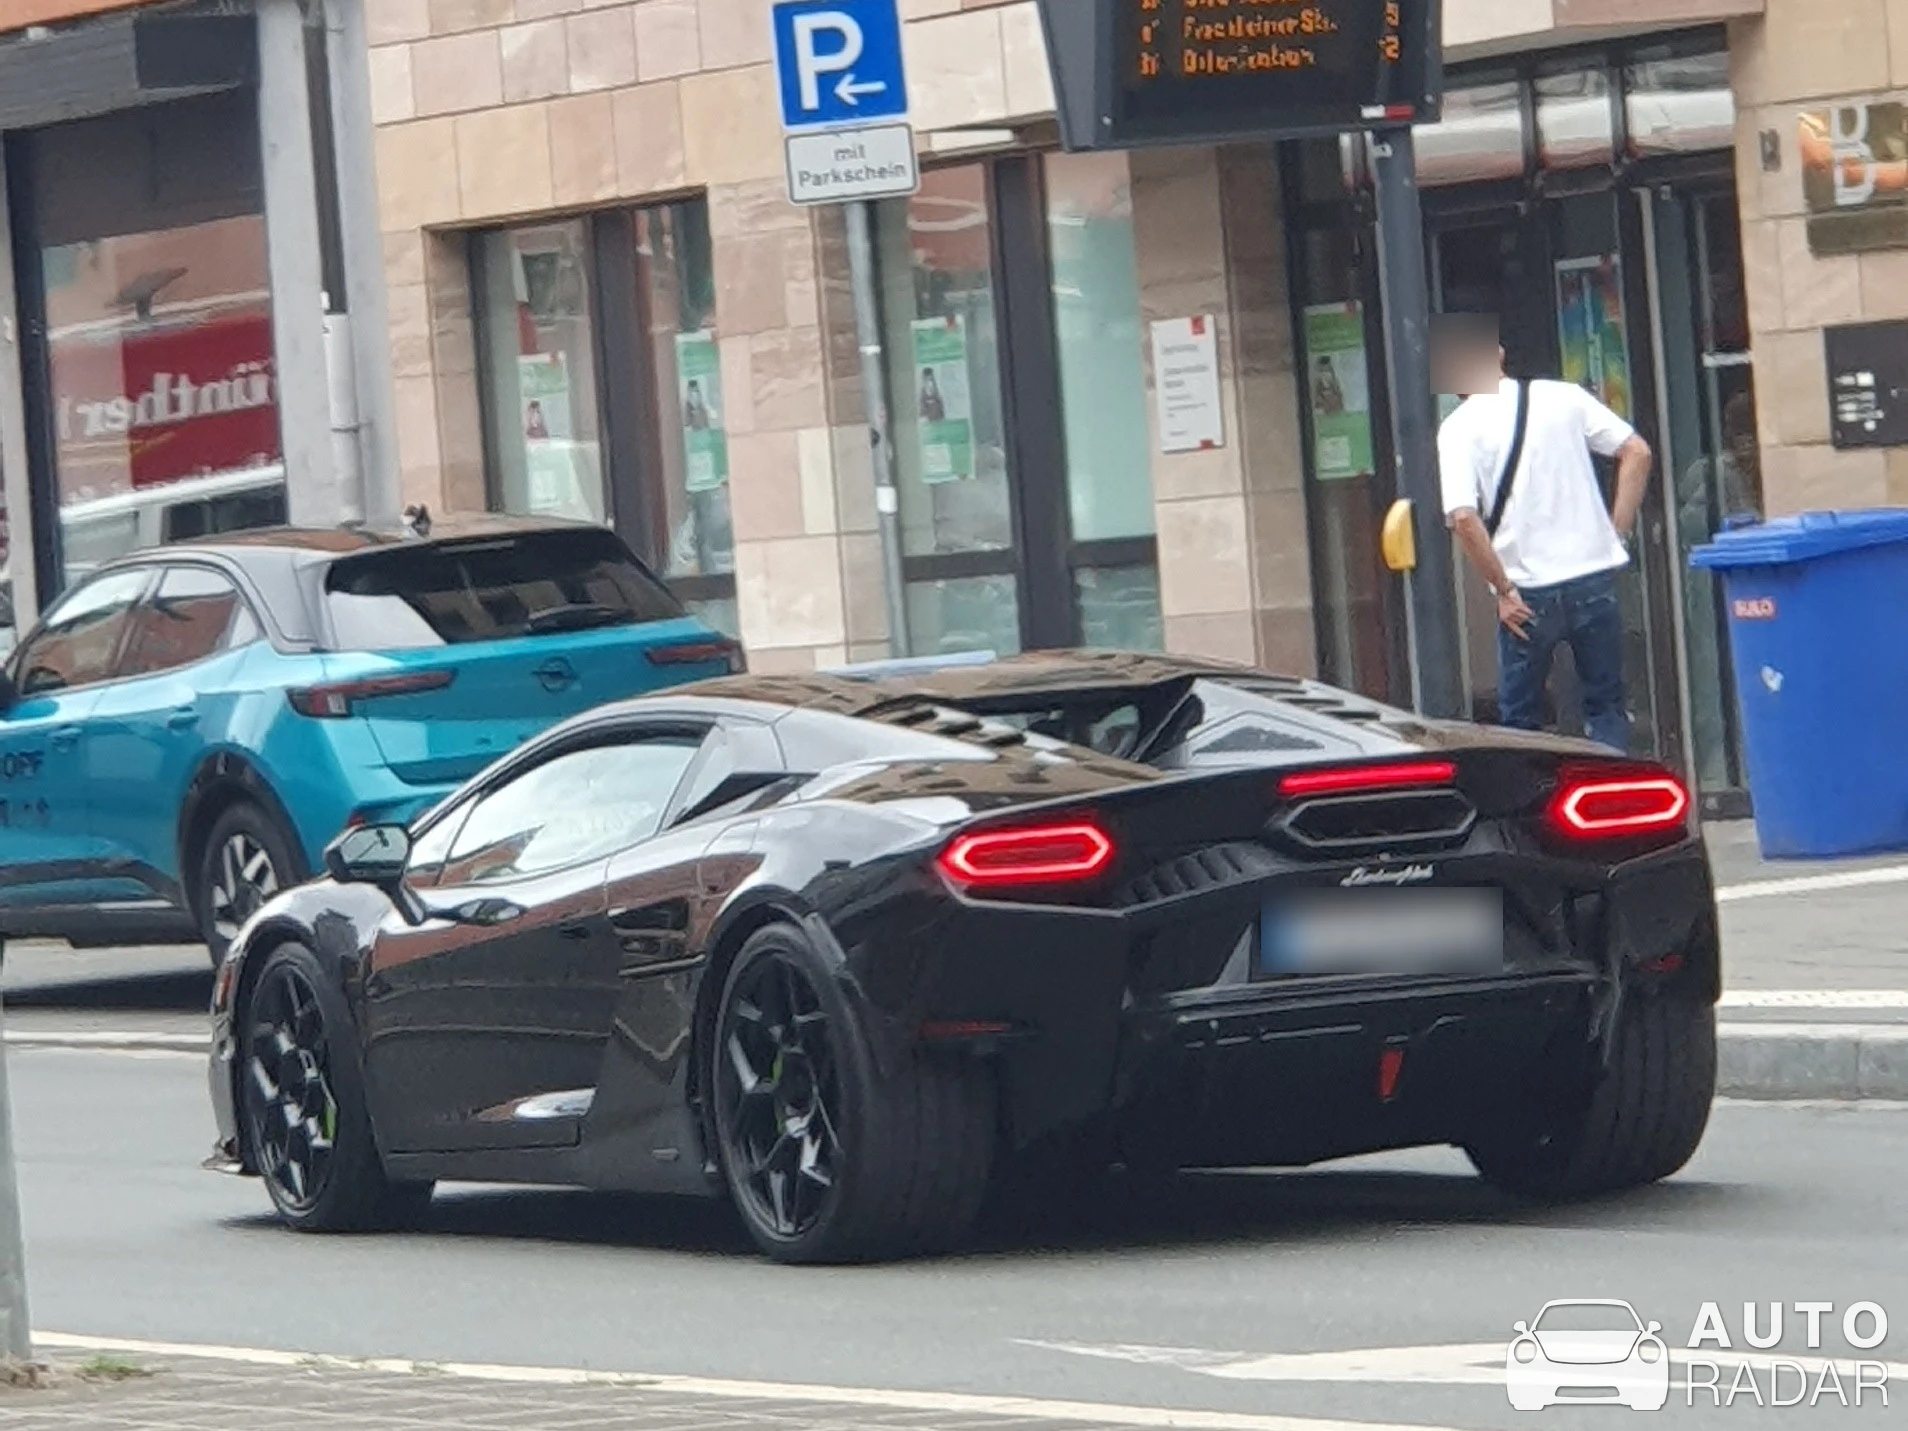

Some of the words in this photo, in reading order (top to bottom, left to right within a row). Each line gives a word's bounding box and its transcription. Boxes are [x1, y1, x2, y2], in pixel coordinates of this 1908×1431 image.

[793, 11, 863, 110] P
[834, 143, 866, 162] mit
[799, 161, 907, 188] Parkschein
